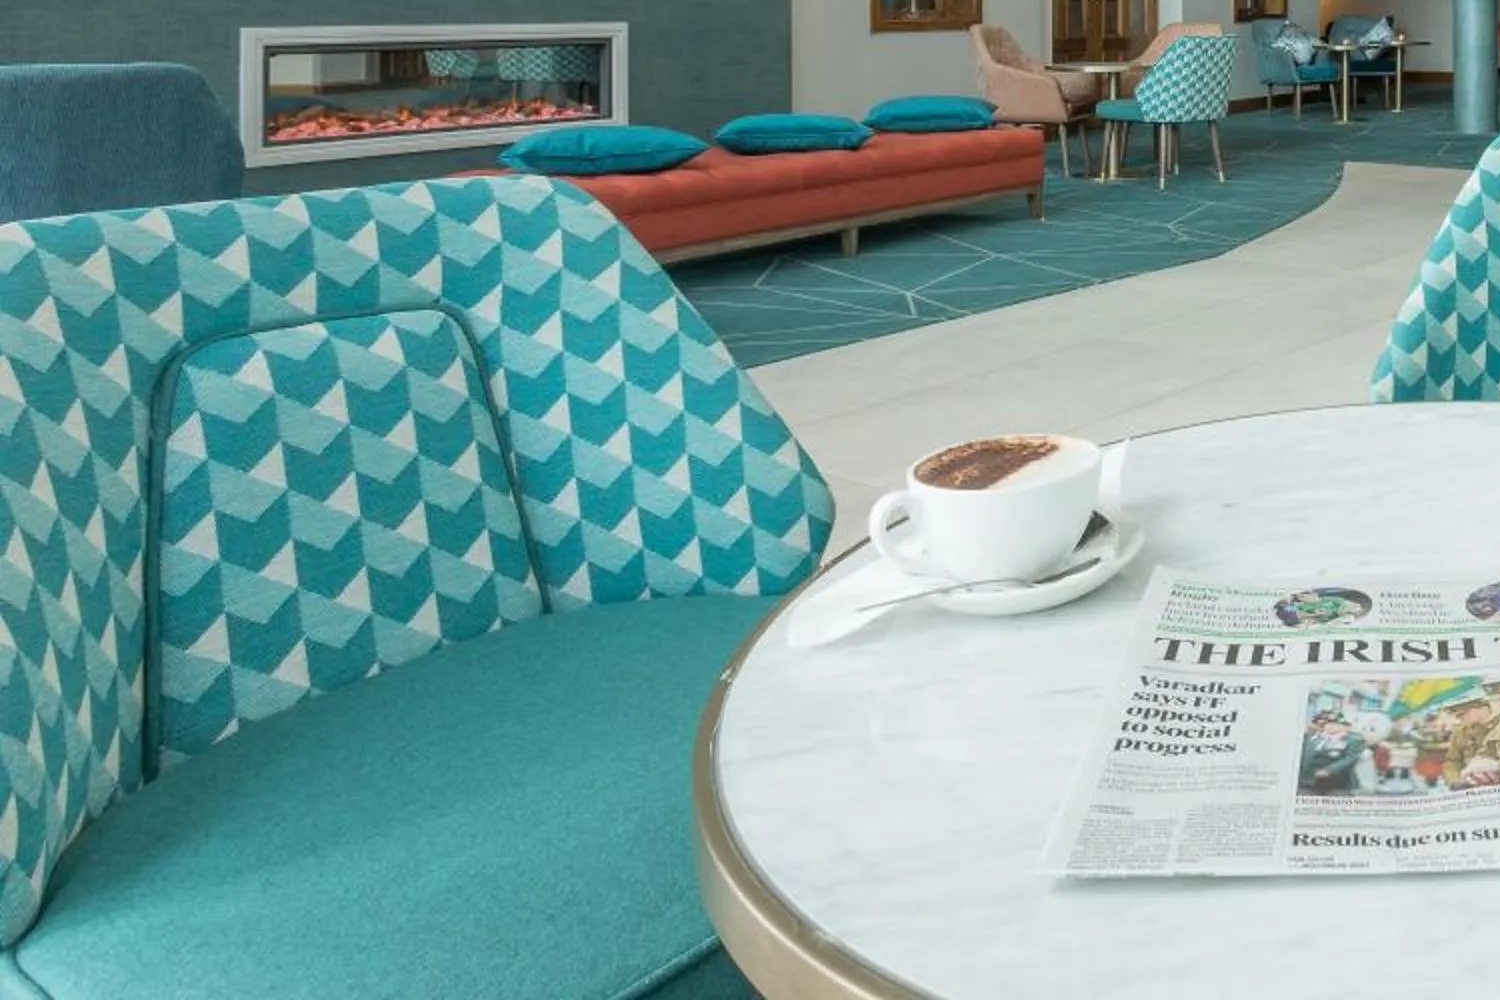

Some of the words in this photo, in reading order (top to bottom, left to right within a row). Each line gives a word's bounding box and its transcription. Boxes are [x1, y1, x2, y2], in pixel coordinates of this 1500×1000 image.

[1154, 637, 1285, 666] THE
[1306, 637, 1478, 664] IRISH
[1139, 675, 1261, 695] Varadkar
[1131, 691, 1187, 707] says
[1193, 696, 1226, 709] FF
[1125, 706, 1239, 723] opposed
[1120, 720, 1149, 733] to
[1152, 724, 1232, 739] social
[1113, 737, 1237, 757] progress
[1292, 832, 1382, 848] Results
[1385, 833, 1432, 849] due
[1435, 829, 1467, 844] on
